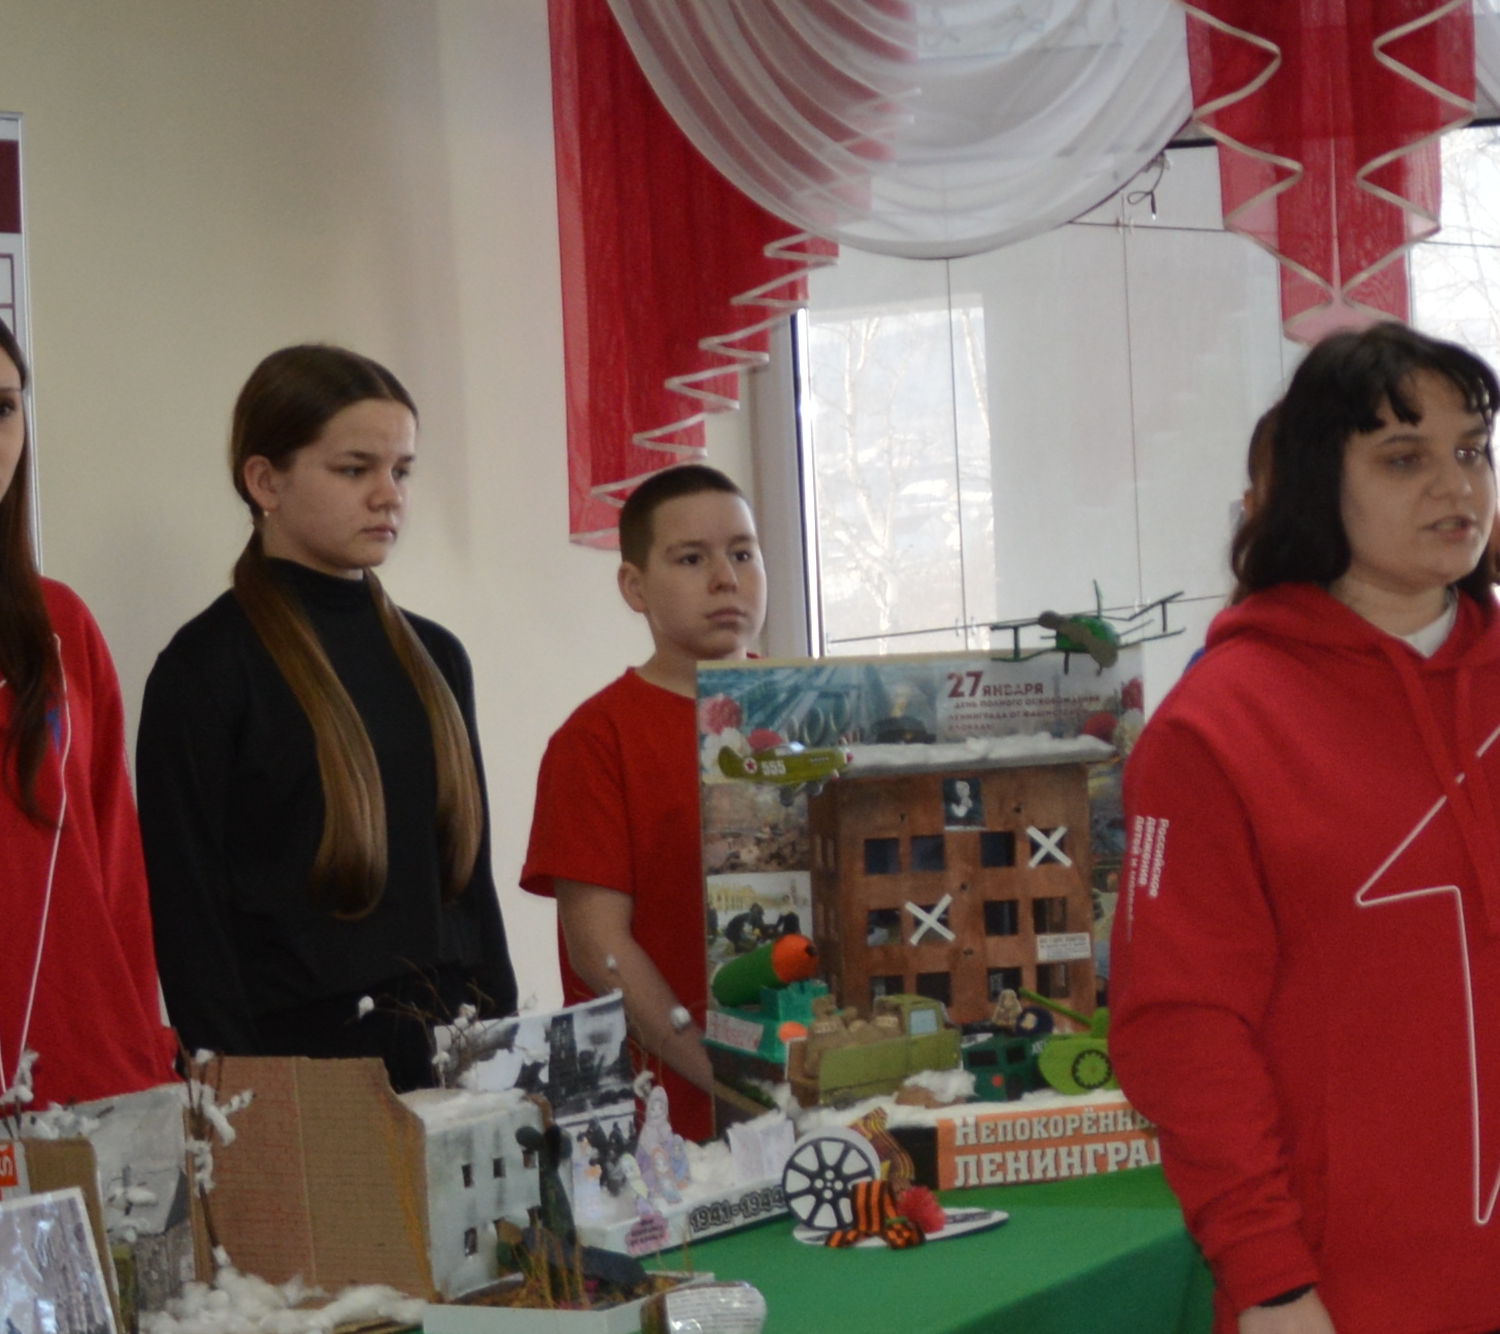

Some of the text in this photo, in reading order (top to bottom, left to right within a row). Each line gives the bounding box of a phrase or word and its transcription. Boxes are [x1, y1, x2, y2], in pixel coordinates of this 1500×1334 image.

[947, 670, 1044, 698] 27 ЯНВАРЯ
[761, 759, 787, 777] 555
